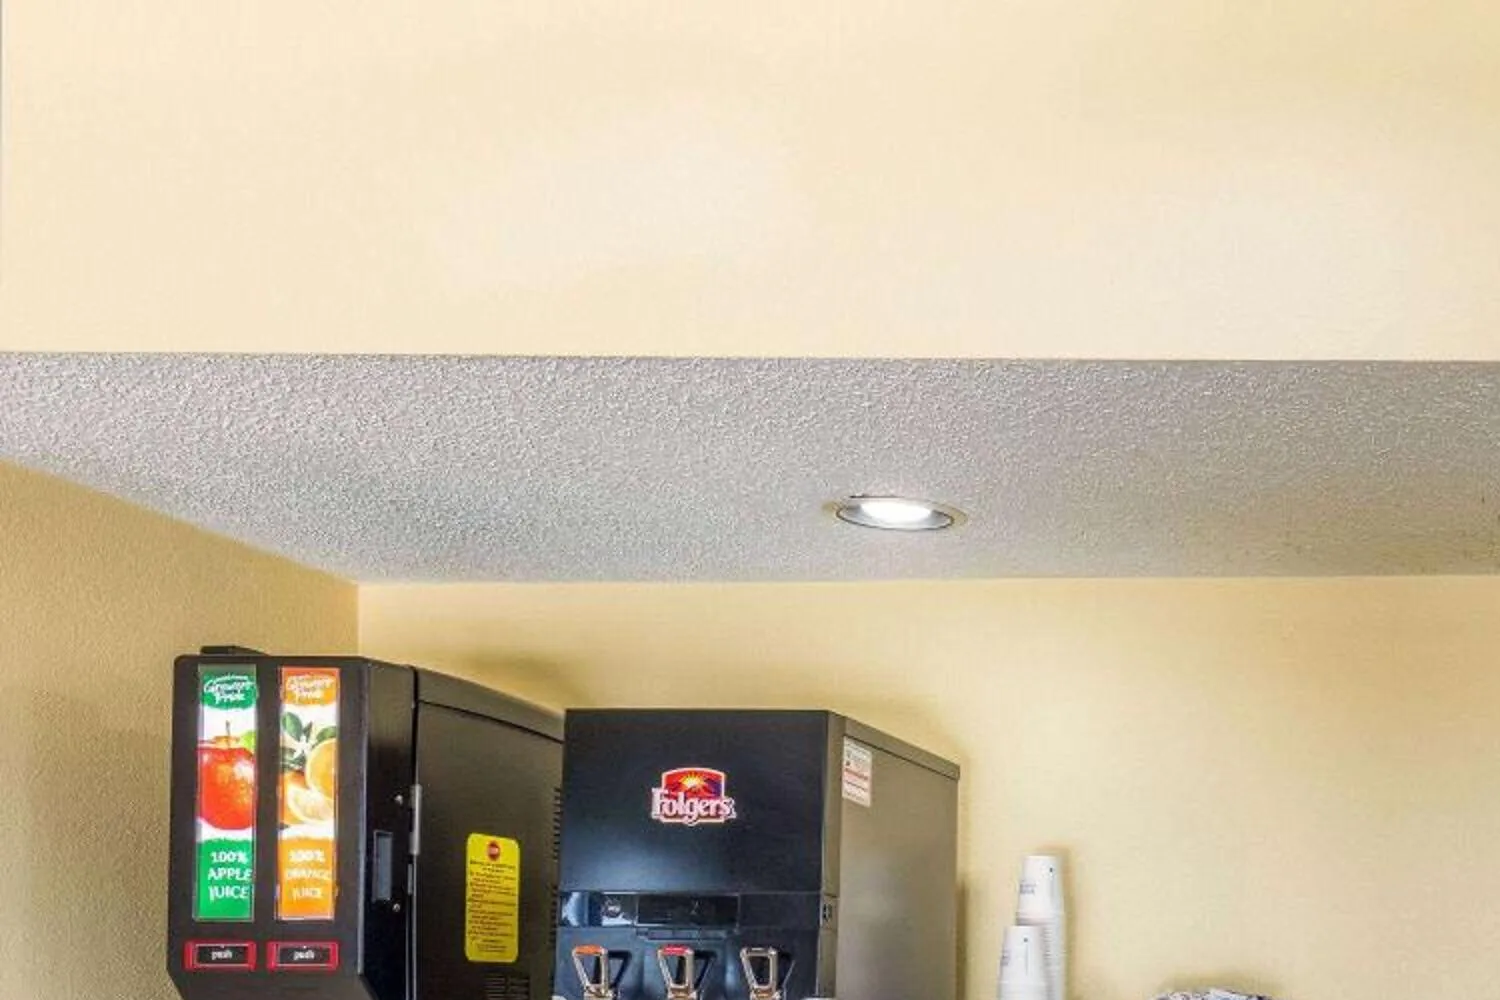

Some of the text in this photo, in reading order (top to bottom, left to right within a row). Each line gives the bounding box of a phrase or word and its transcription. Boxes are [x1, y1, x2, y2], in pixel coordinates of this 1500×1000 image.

[651, 787, 736, 826] Folgers
[210, 851, 249, 864] 100%
[207, 867, 253, 881] APPLE
[208, 885, 249, 901] JUICE
